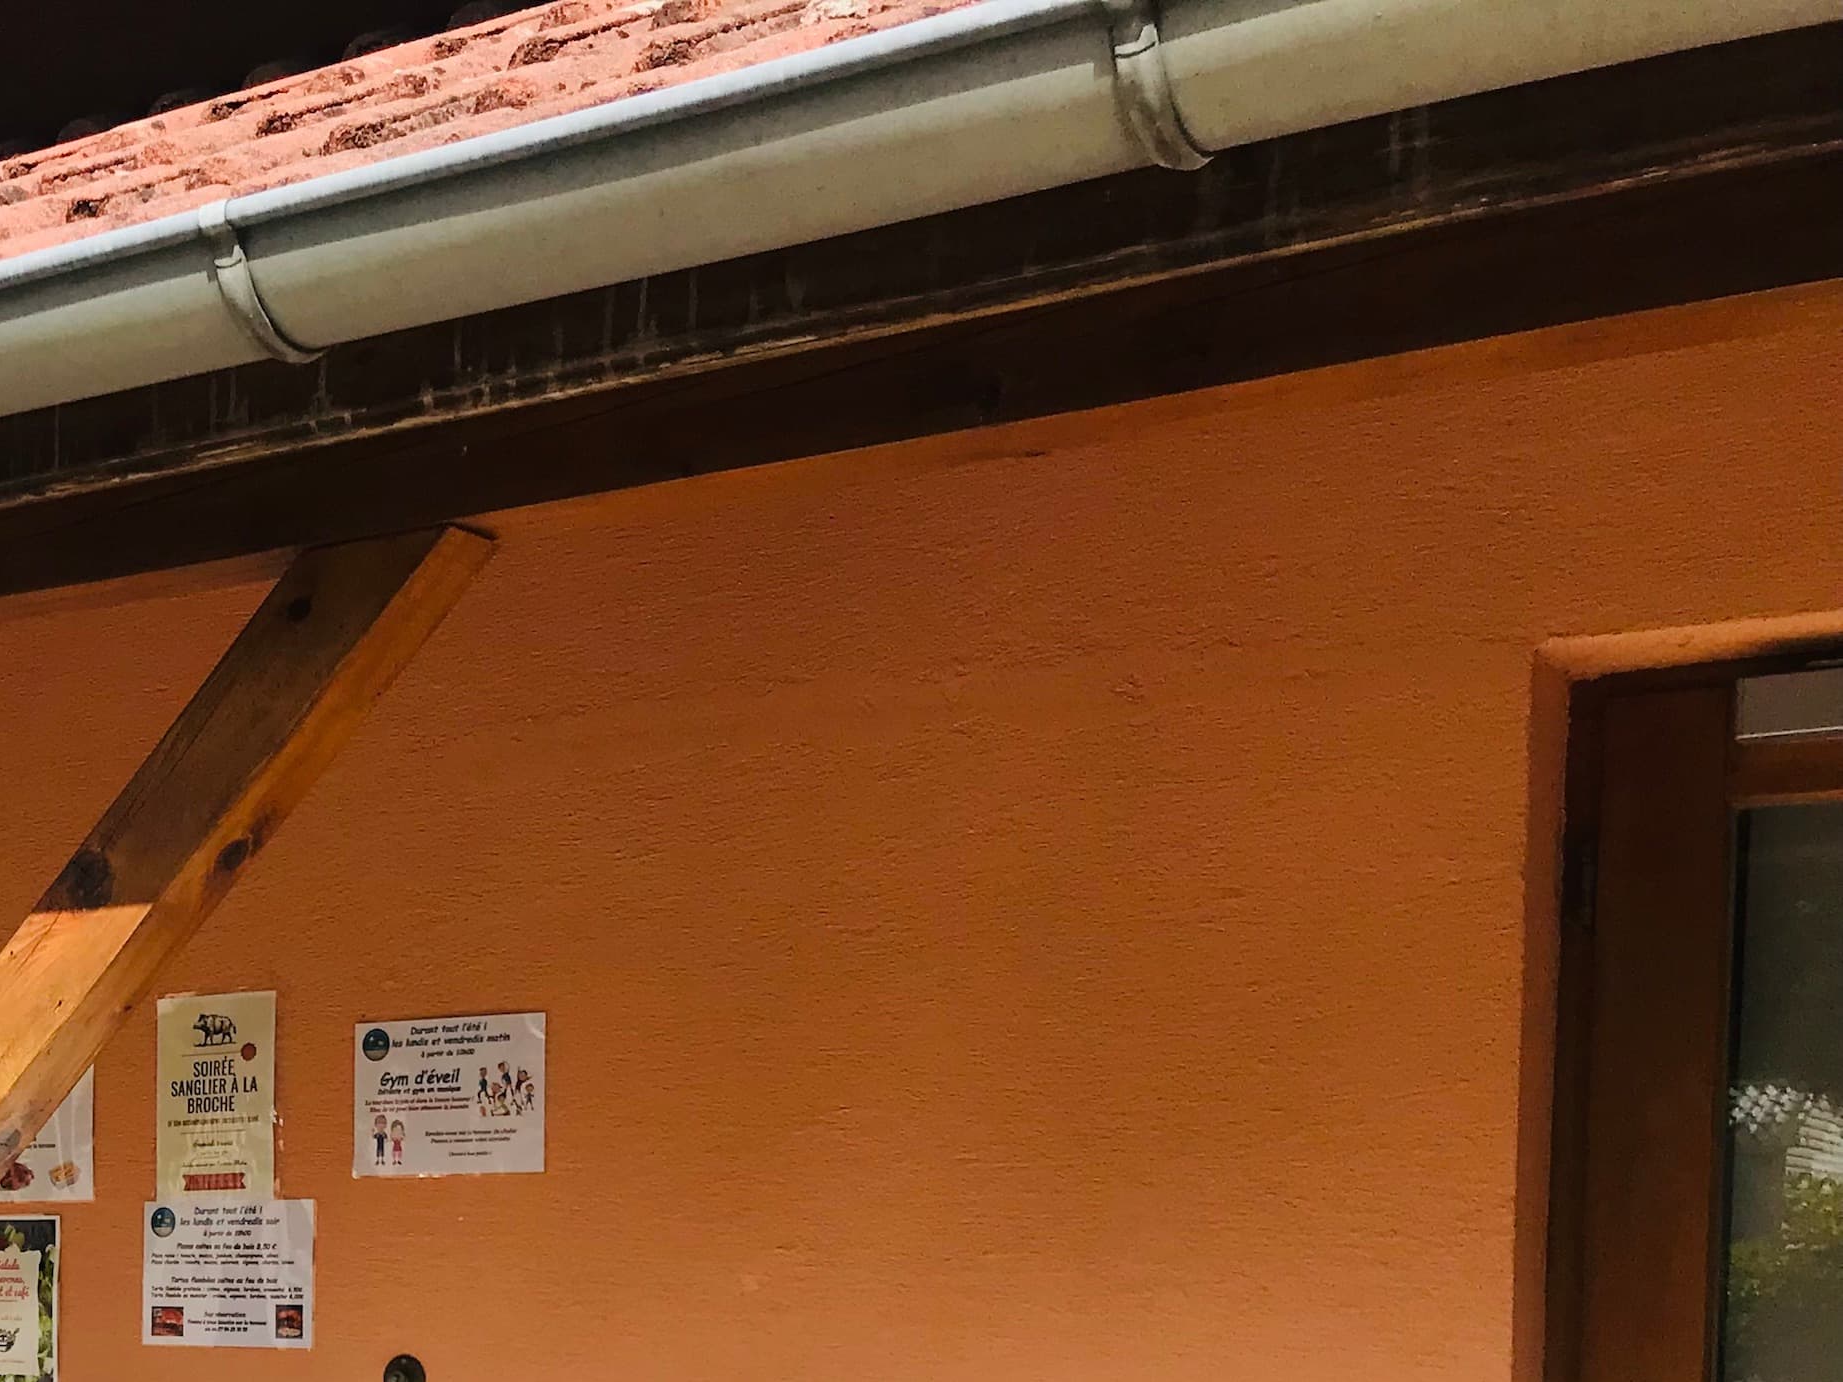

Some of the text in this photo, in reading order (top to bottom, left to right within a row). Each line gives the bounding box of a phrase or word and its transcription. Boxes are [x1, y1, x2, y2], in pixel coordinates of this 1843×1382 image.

[442, 1025, 460, 1034] tout
[406, 1038, 429, 1047] lundis
[432, 1037, 442, 1046] et
[444, 1034, 484, 1044] vendredis
[486, 1032, 512, 1042] matin
[193, 1056, 235, 1077] SOIRÉE
[171, 1073, 257, 1097] SANGLIER À LA
[380, 1068, 461, 1089] Gym d'éveil
[187, 1096, 235, 1113] BROCHE
[222, 1207, 237, 1215] tout
[193, 1217, 213, 1226] lundis
[216, 1218, 225, 1226] et
[227, 1217, 263, 1226] vendredis
[265, 1217, 280, 1225] soir
